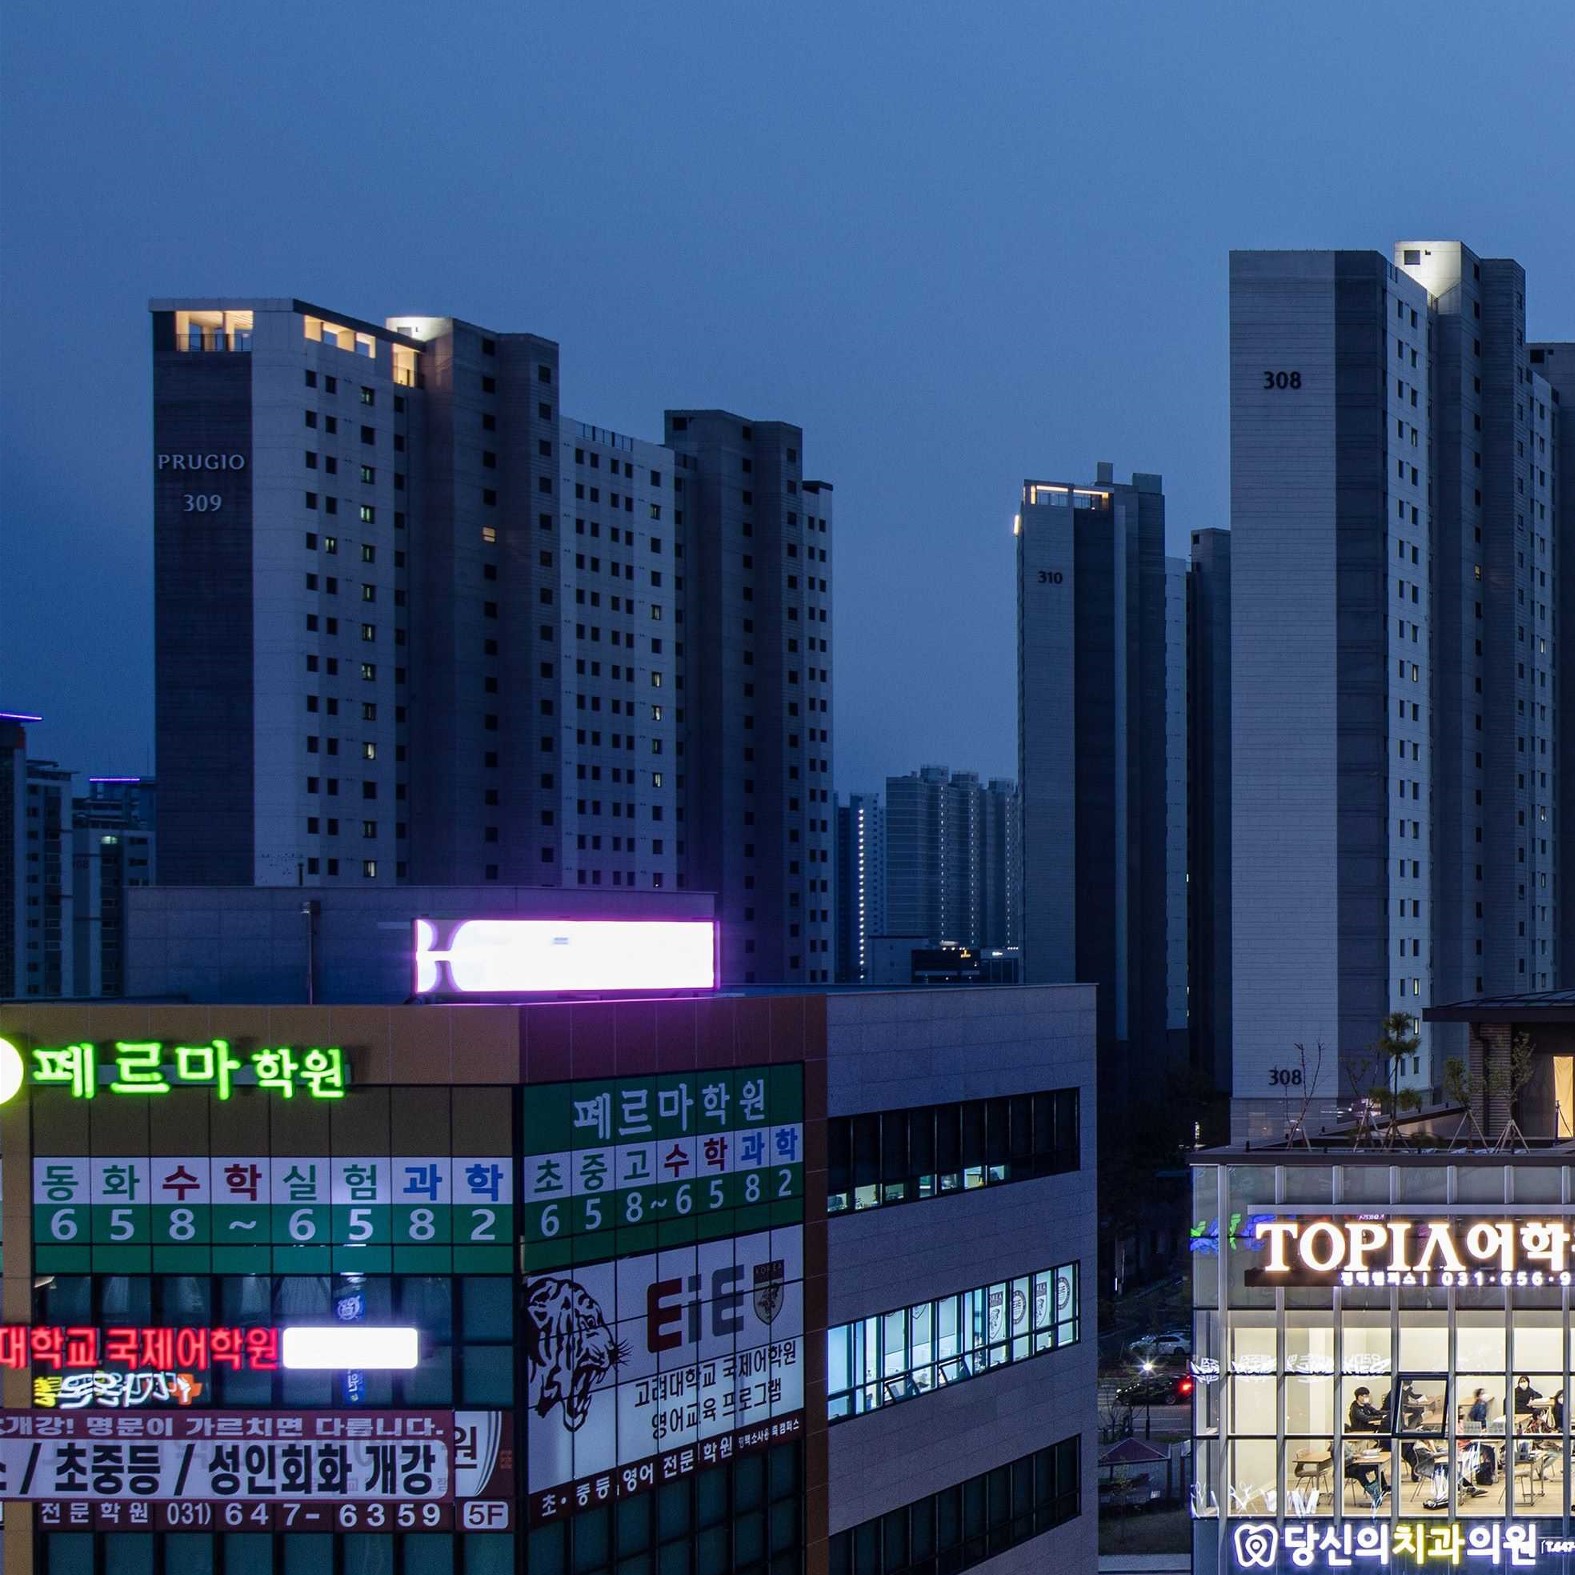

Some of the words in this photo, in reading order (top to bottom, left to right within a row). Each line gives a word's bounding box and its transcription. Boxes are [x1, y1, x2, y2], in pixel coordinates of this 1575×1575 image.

[1263, 371, 1302, 389] 308
[157, 454, 246, 471] PRUGIO
[183, 494, 222, 513] 309
[33, 1039, 346, 1100] 페르마학원
[1269, 1069, 1302, 1086] 308
[573, 1079, 767, 1140] 페르마학원
[106, 1326, 279, 1371] 국제어학원
[634, 1366, 716, 1408] 고려대학교
[723, 1340, 797, 1383] 국제어학원
[86, 1416, 174, 1437] 명문이
[185, 1416, 304, 1437] 가르치면
[315, 1416, 445, 1437] 다릅니다.
[651, 1399, 716, 1440] 영어교육
[721, 1377, 782, 1418] 프로그램
[54, 1442, 162, 1496] 초중등
[207, 1442, 352, 1496] 성인회화
[364, 1442, 436, 1496] 개강
[622, 1461, 655, 1494] 영어
[663, 1449, 694, 1479] 전문
[703, 1436, 733, 1463] 학원
[468, 1502, 506, 1525] 5F
[1284, 1522, 1537, 1568] 당신의치과의원
